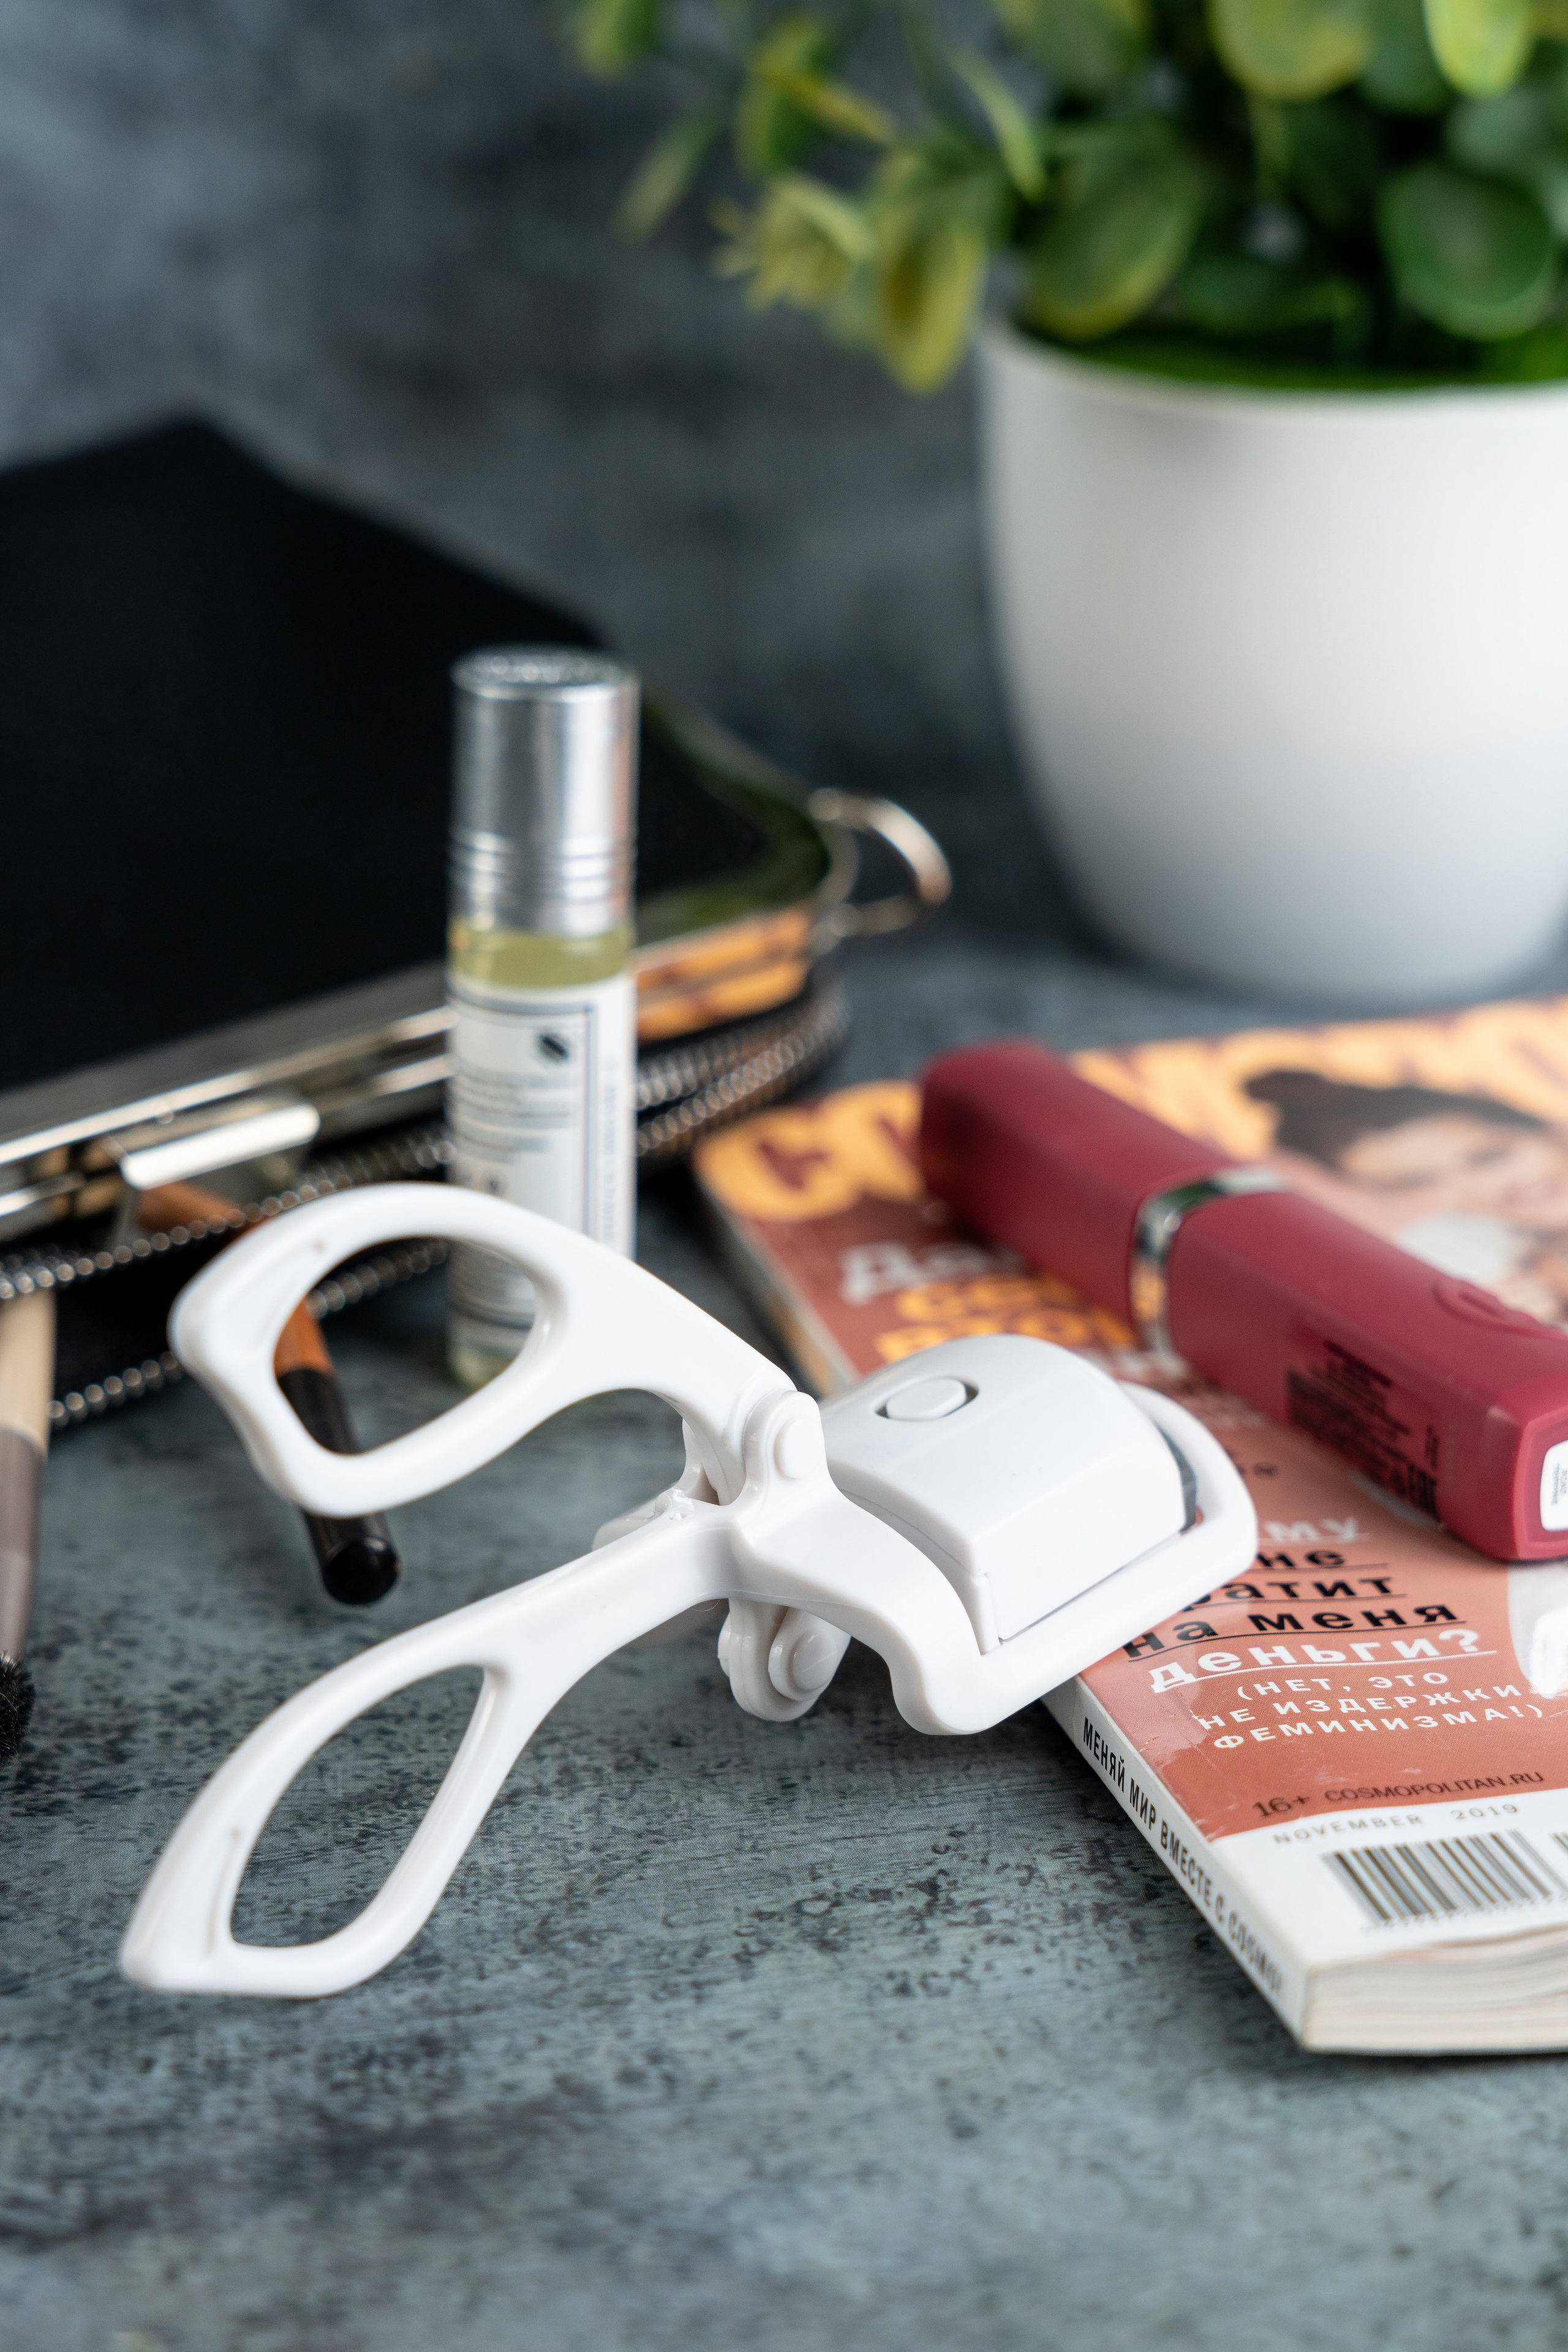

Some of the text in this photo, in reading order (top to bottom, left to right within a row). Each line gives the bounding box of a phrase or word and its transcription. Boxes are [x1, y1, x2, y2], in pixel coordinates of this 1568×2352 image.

[1180, 1577, 1392, 1611] атит
[1124, 1604, 1458, 1659] на меня
[1148, 1629, 1479, 1694] деньги?
[1199, 1684, 1522, 1730] НЕ ИЗДЕРЖКИ
[1237, 1672, 1449, 1701] (НЕТ, ЭТО
[1213, 1704, 1543, 1749] ФЕМИНИЗМА!)
[1083, 1716, 1125, 1793] МЕНЯЙ
[1129, 1777, 1157, 1831] МИР
[1160, 1819, 1212, 1908] ВМЕСТЕ
[1253, 1771, 1544, 1817] 16+ COSMOPOLITAN.RU
[1273, 1803, 1519, 1845] NOVEMBER 2019
